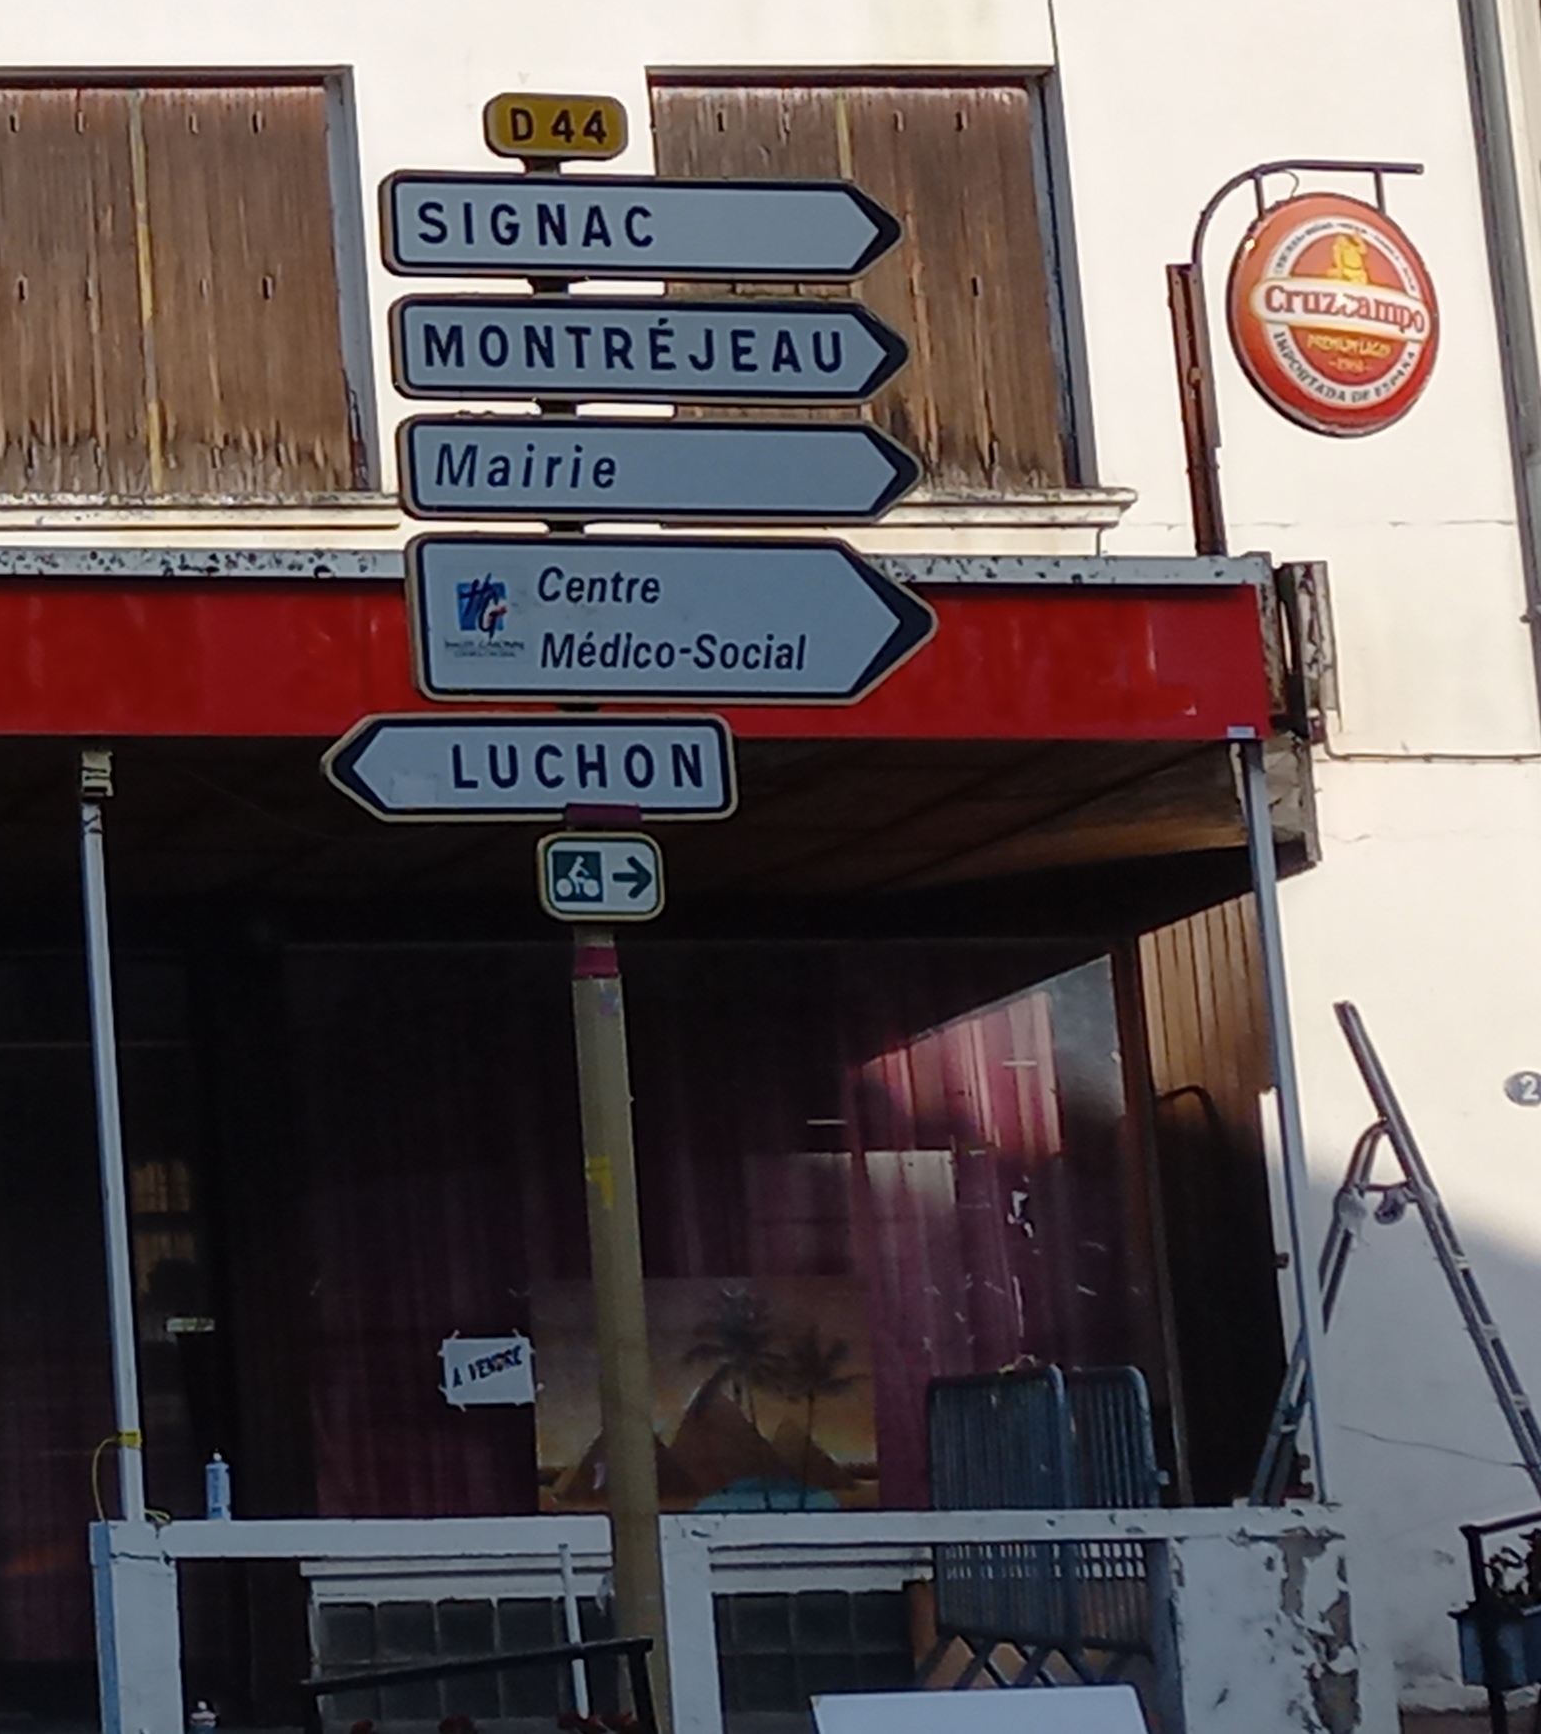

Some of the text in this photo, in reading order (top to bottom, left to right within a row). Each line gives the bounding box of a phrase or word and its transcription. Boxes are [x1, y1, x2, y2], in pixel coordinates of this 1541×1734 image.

[509, 107, 608, 145] D 44
[417, 201, 655, 249] SIGNAC
[422, 317, 843, 374] MONTRÉJEAU
[434, 442, 618, 489] Mairie
[537, 566, 661, 604] Centre
[540, 630, 808, 672] Médico-Social
[451, 743, 704, 789] LUCHON
[1519, 1075, 1540, 1100] 2
